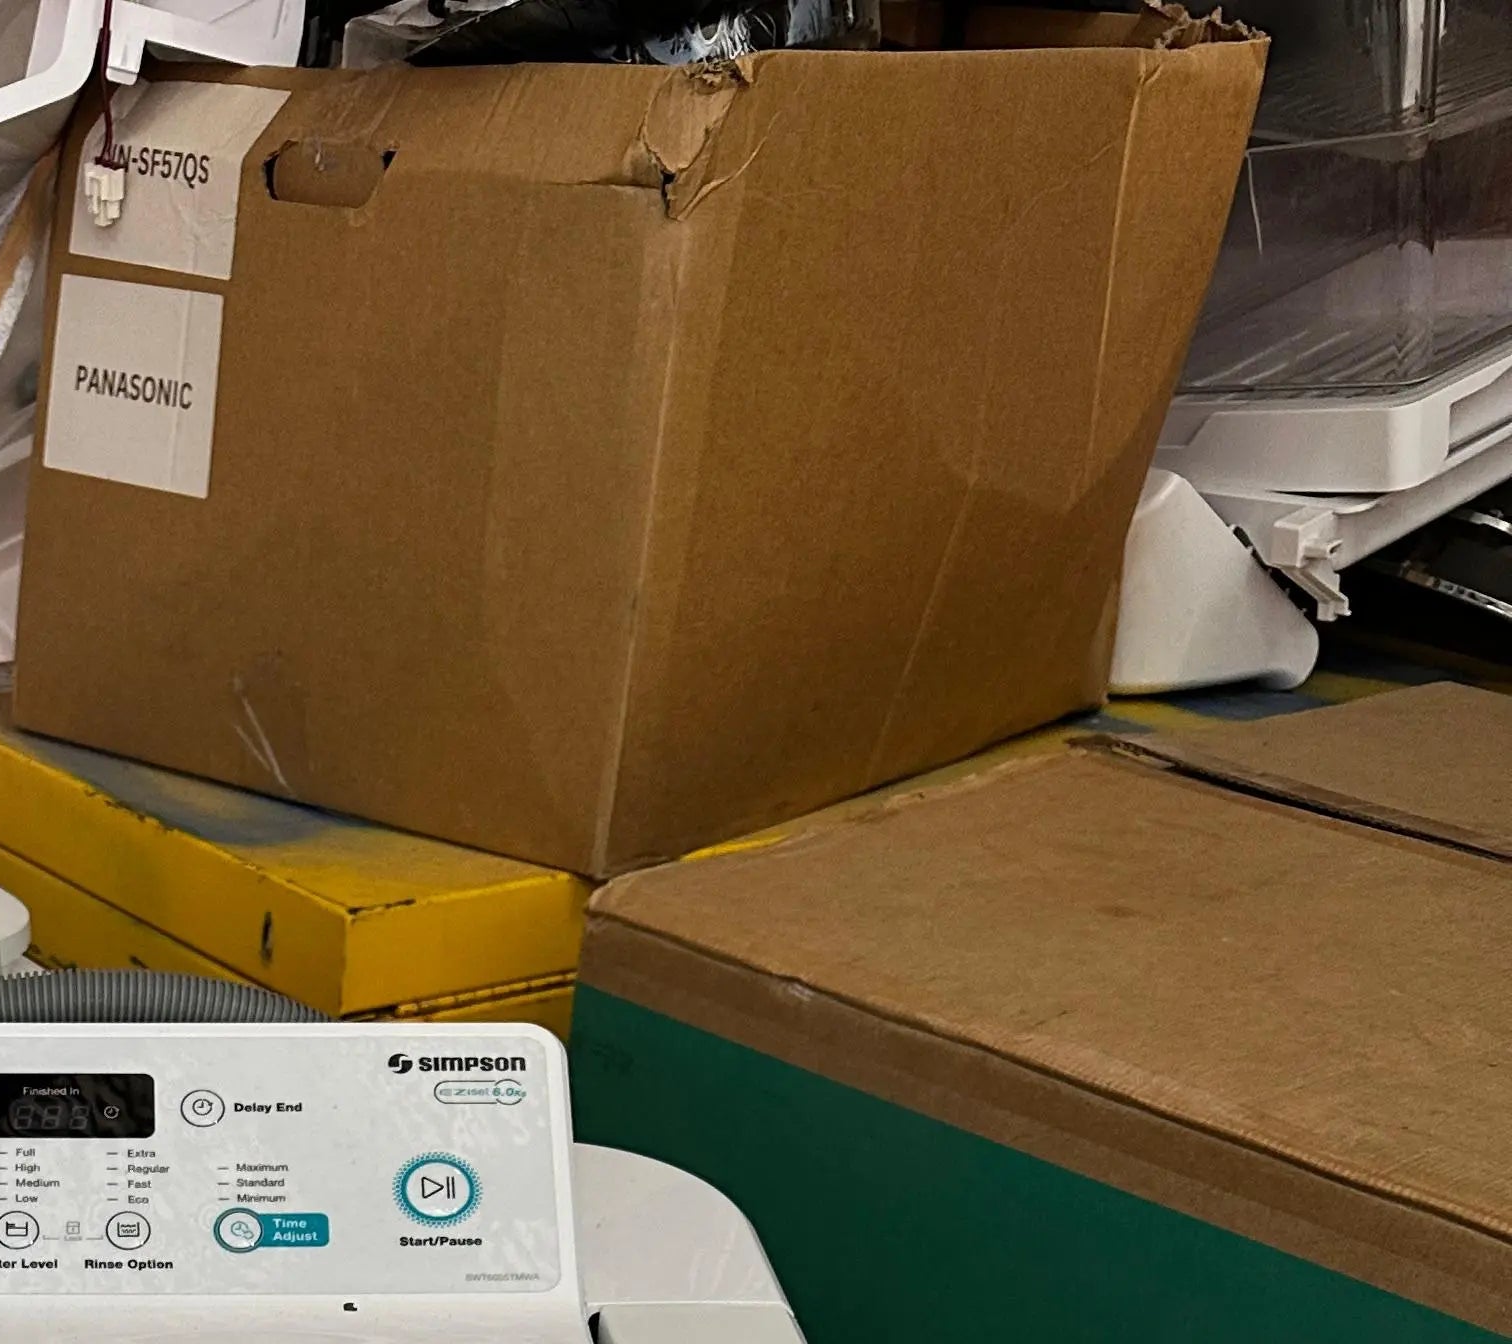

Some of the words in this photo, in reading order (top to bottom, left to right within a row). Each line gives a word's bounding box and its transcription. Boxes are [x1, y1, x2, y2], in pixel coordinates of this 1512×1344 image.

[74, 365, 193, 410] PANASONIC
[23, 1087, 67, 1096] Finished
[234, 1102, 272, 1114] Delay
[277, 1102, 302, 1112] End
[16, 1148, 35, 1157] Full
[127, 1149, 156, 1158] Extra
[15, 1163, 41, 1174] High
[128, 1165, 170, 1175] Regular
[236, 1163, 288, 1171] Maximum
[16, 1179, 60, 1187] Medium
[127, 1180, 152, 1189] Fast
[236, 1178, 285, 1187] Standard
[15, 1194, 38, 1203] Low
[128, 1195, 149, 1204] Eco
[237, 1194, 286, 1202] Minimum
[273, 1219, 307, 1228] Time
[273, 1230, 317, 1243] Adjust
[399, 1237, 482, 1247] Start/Pause
[22, 1259, 58, 1269] Level
[85, 1259, 123, 1269] Rinse
[128, 1259, 173, 1271] Option
